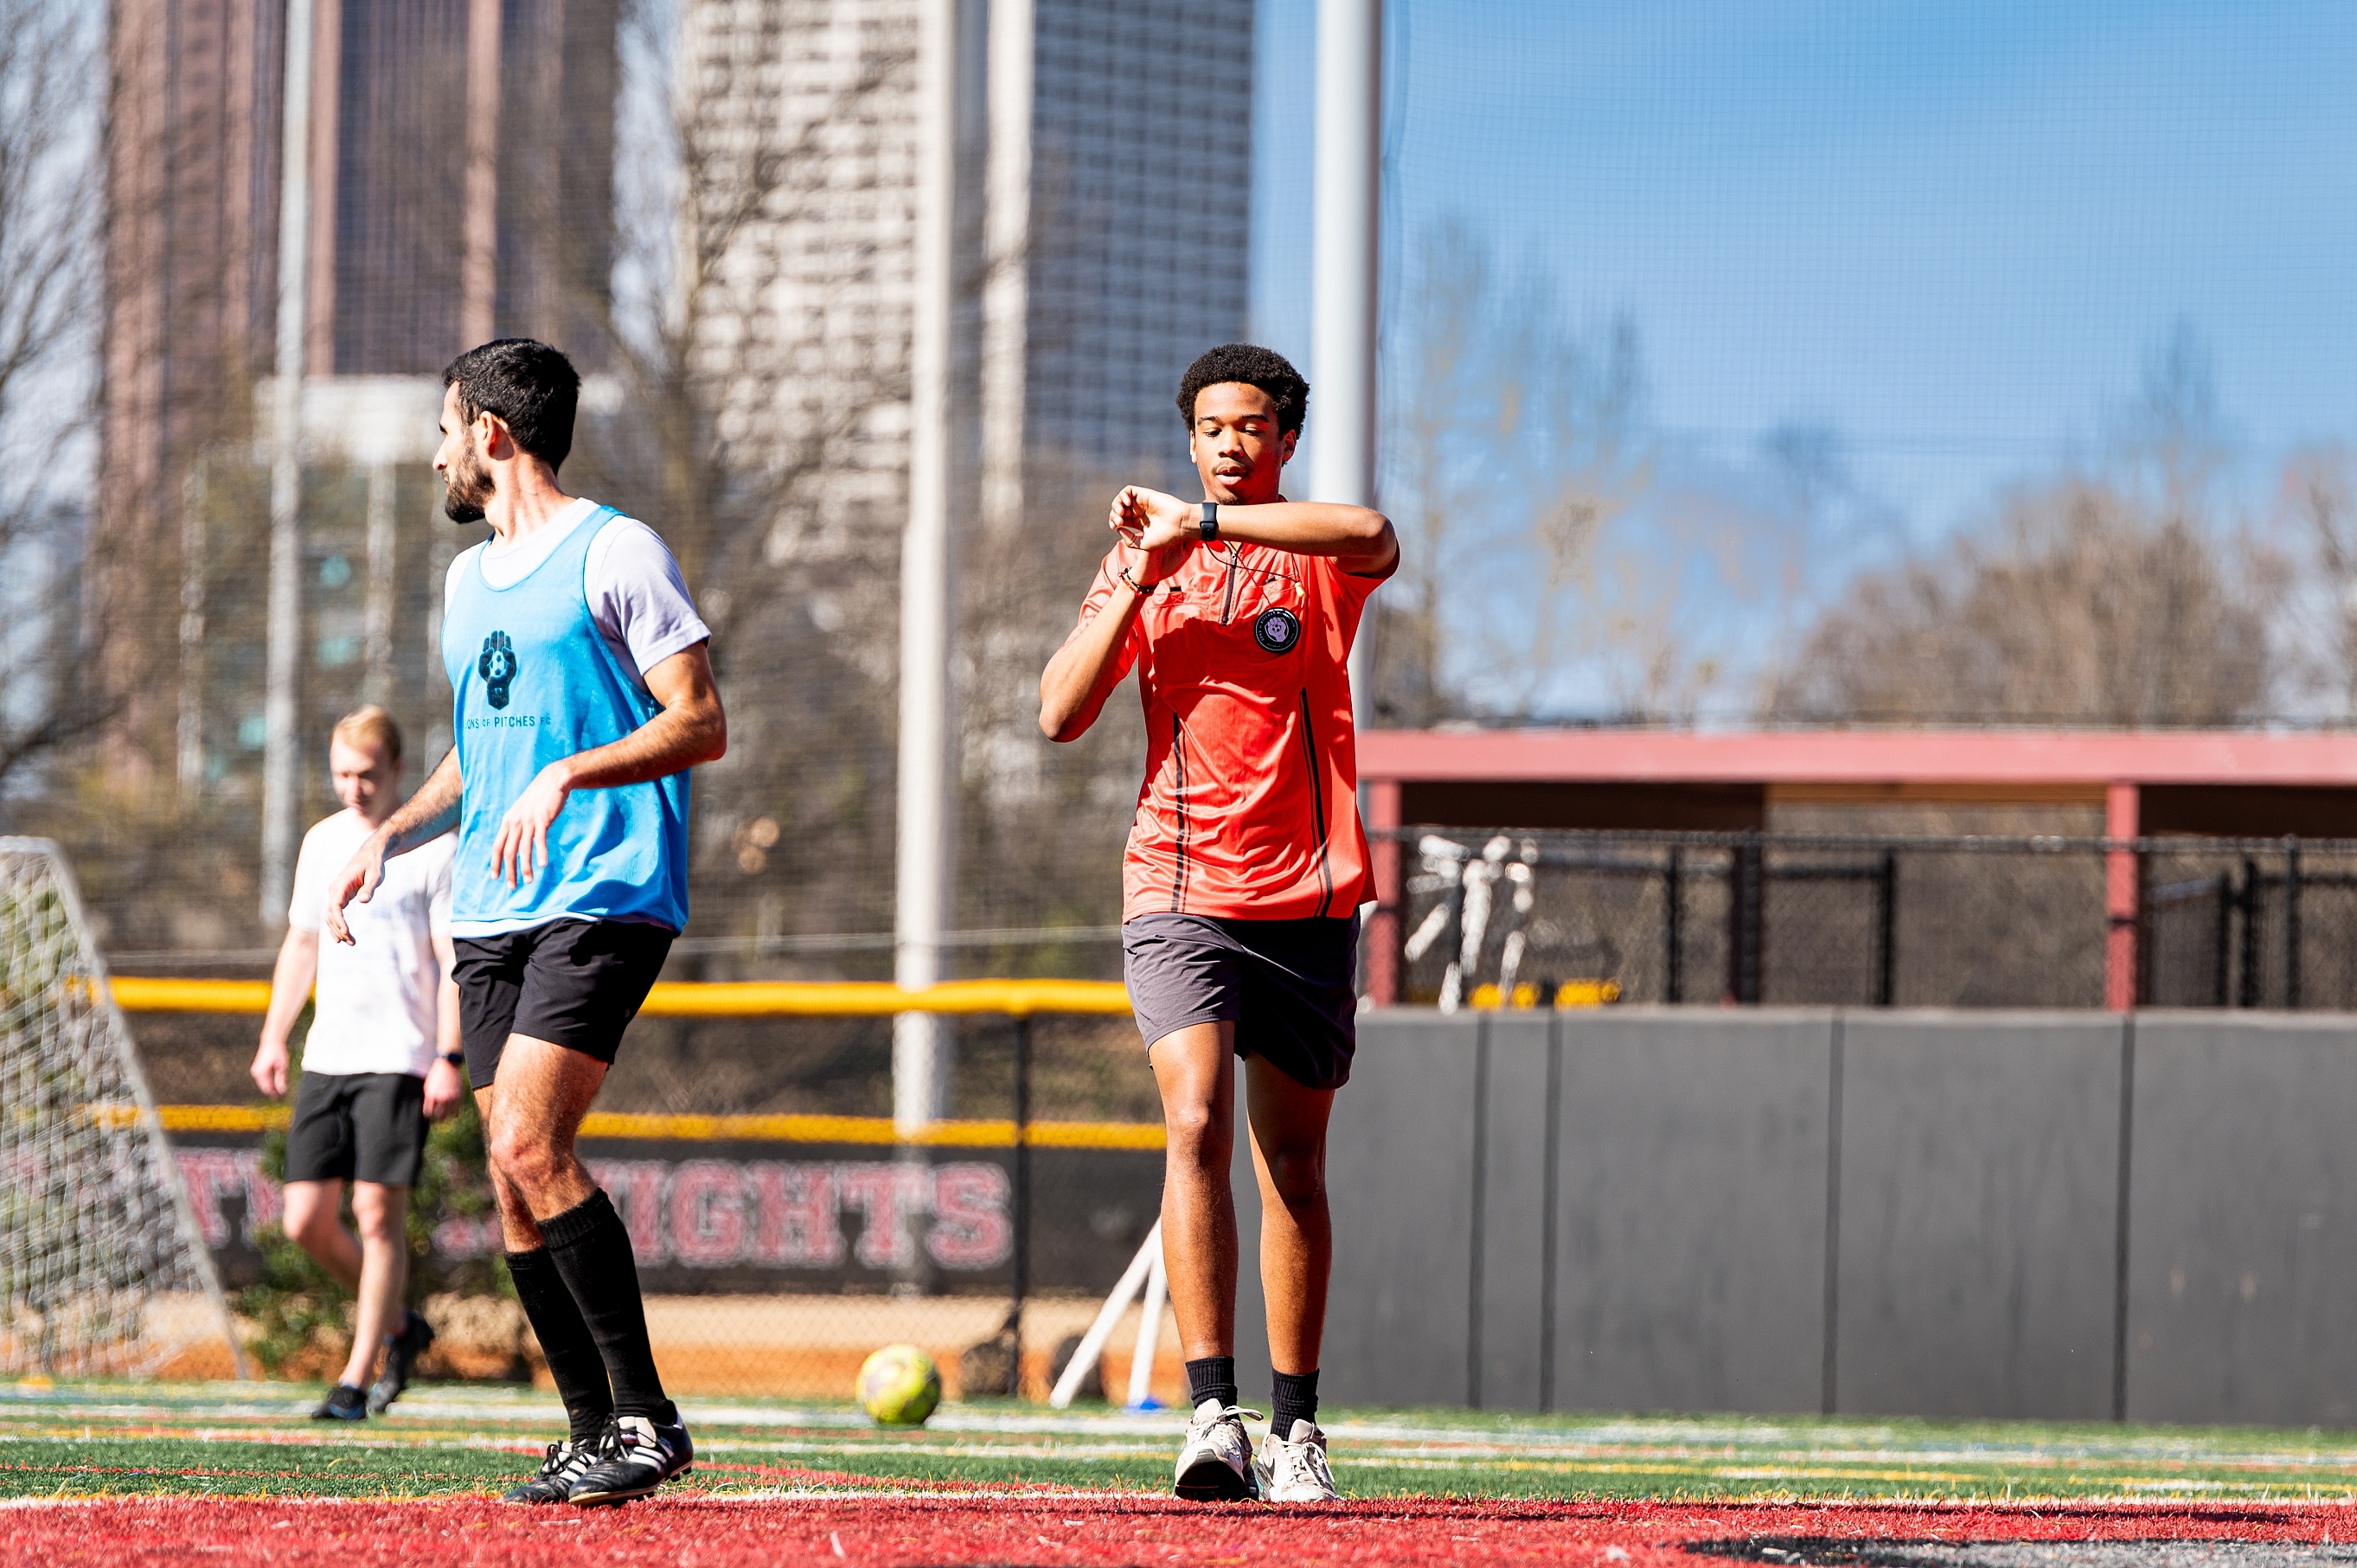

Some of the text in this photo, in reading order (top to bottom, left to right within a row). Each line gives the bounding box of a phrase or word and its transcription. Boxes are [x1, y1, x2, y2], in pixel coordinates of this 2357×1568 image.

[482, 718, 490, 727] OF
[494, 715, 535, 728] PITCHES
[540, 716, 552, 726] FC
[435, 1158, 1015, 1270] IGHTS
